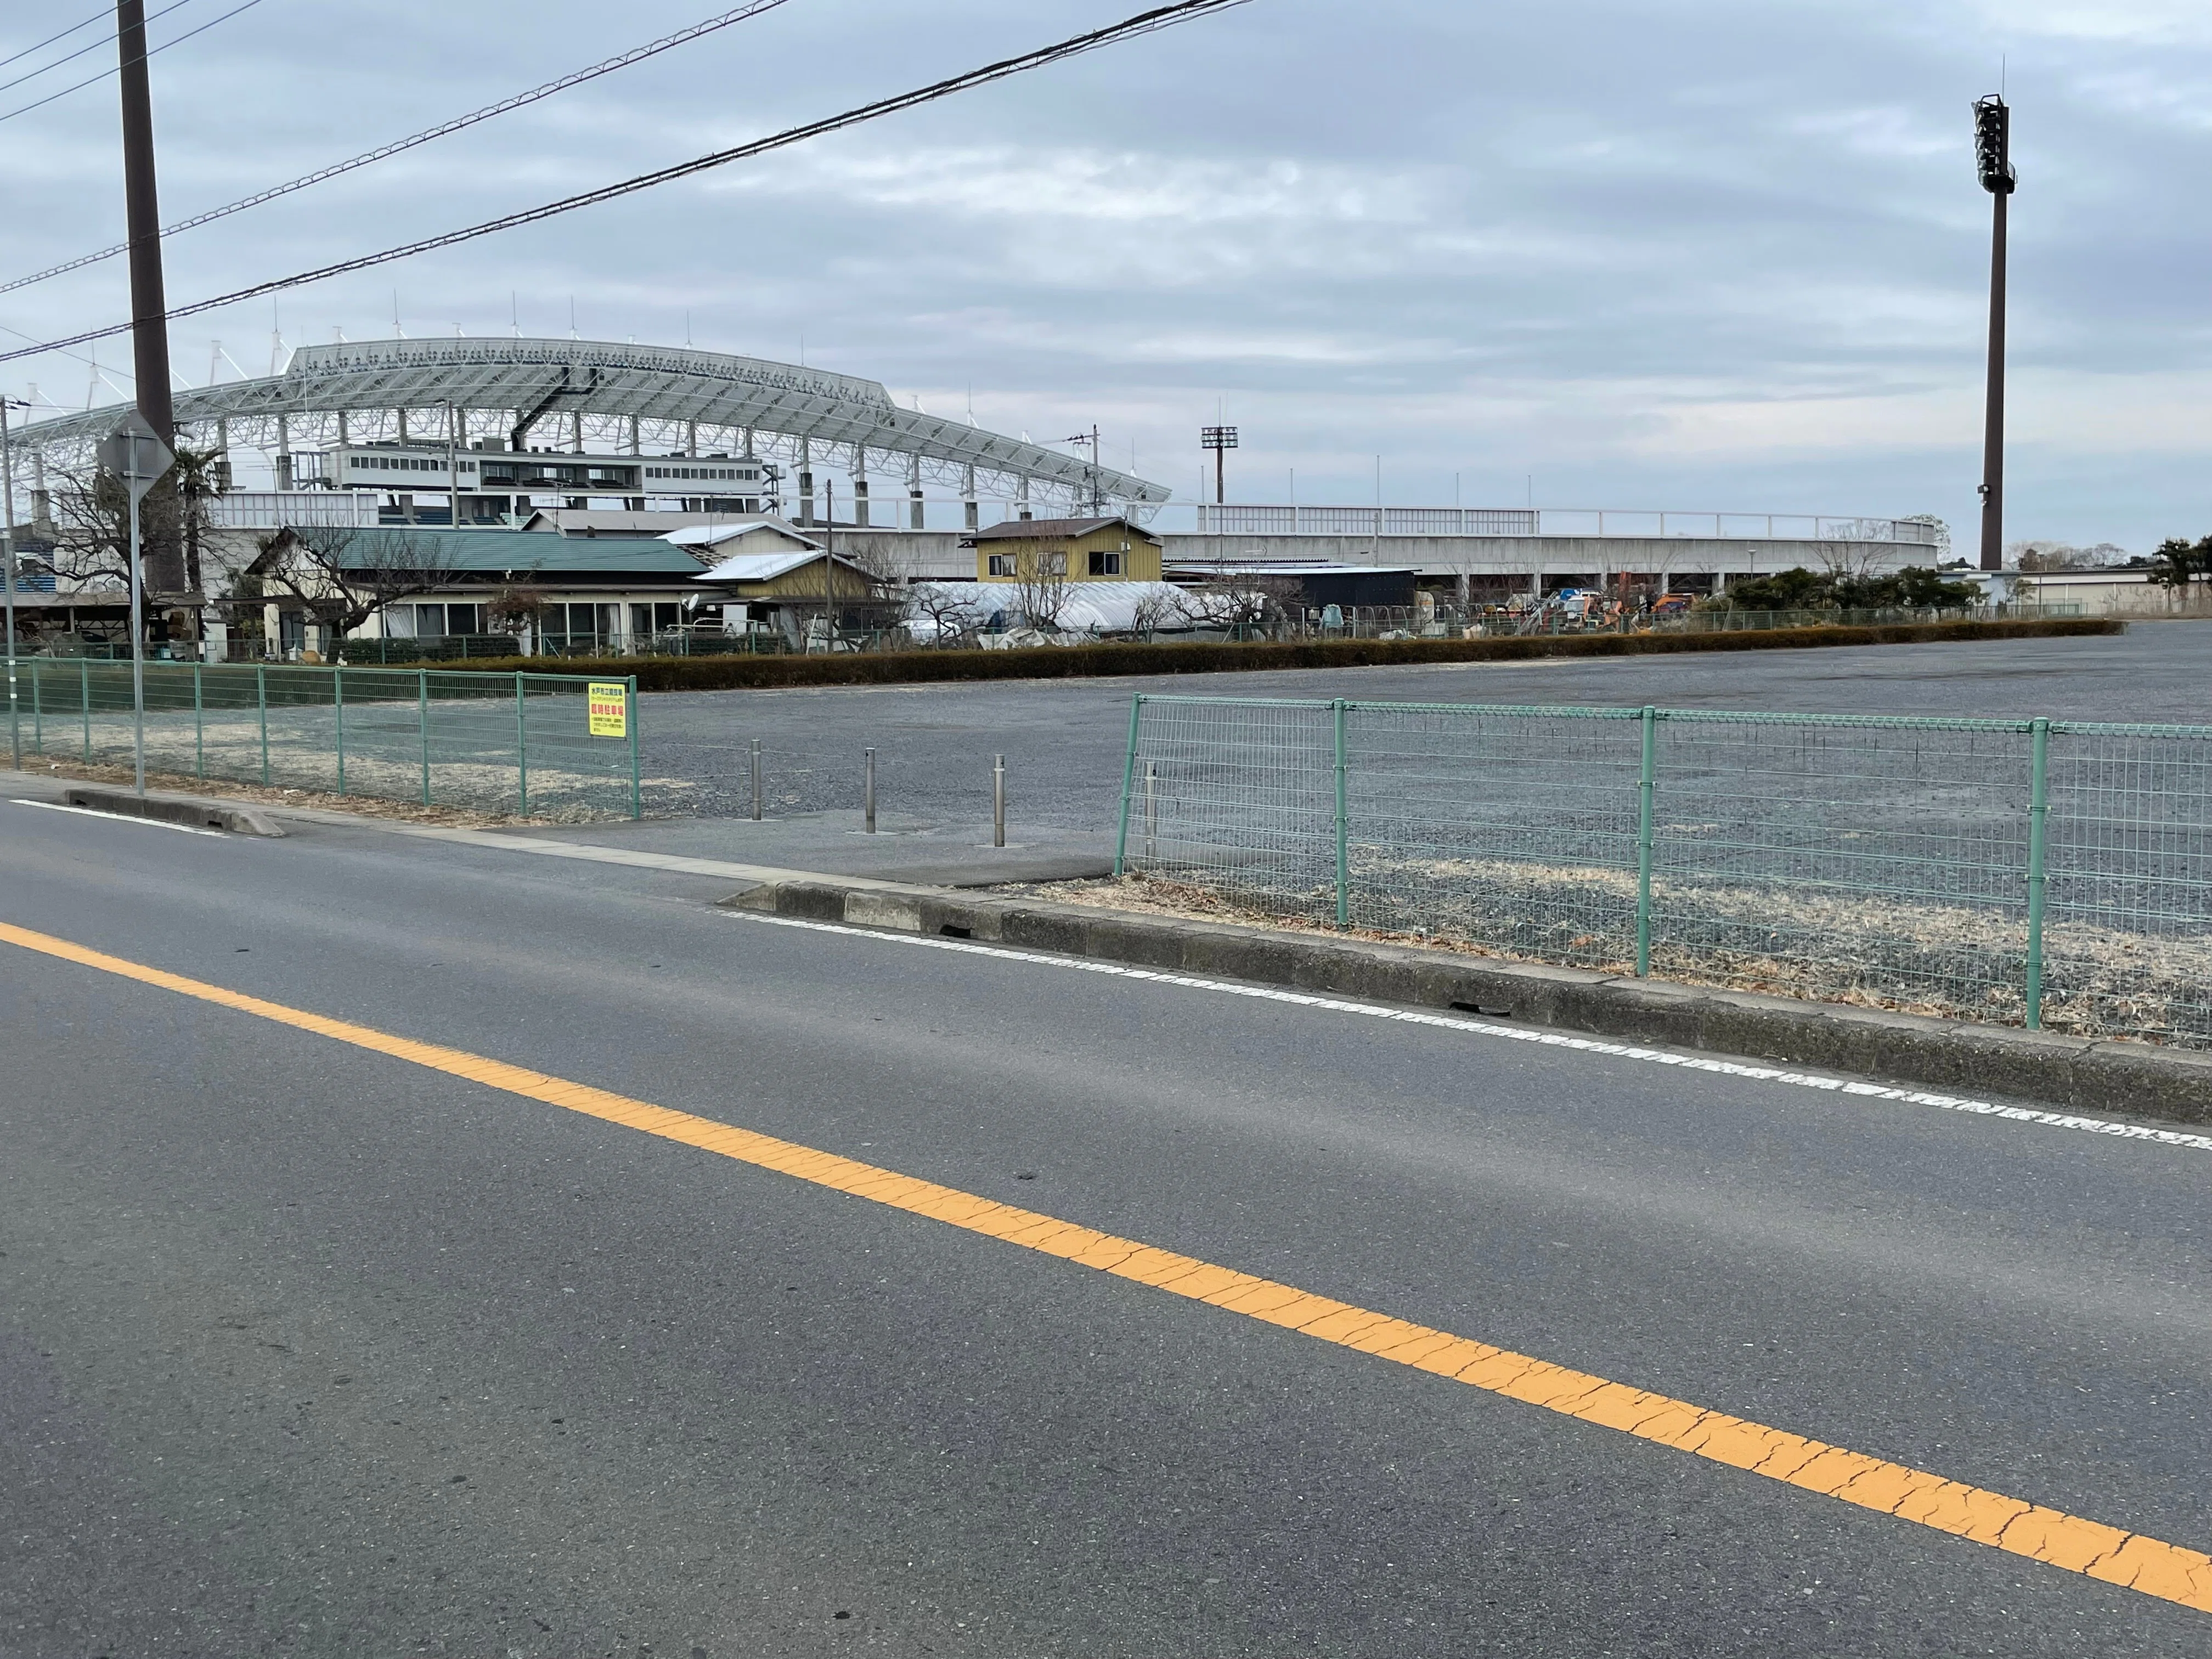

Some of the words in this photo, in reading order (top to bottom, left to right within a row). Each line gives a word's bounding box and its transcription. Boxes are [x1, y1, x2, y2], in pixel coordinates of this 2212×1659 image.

[591, 704, 623, 716] 臨時駐車場
